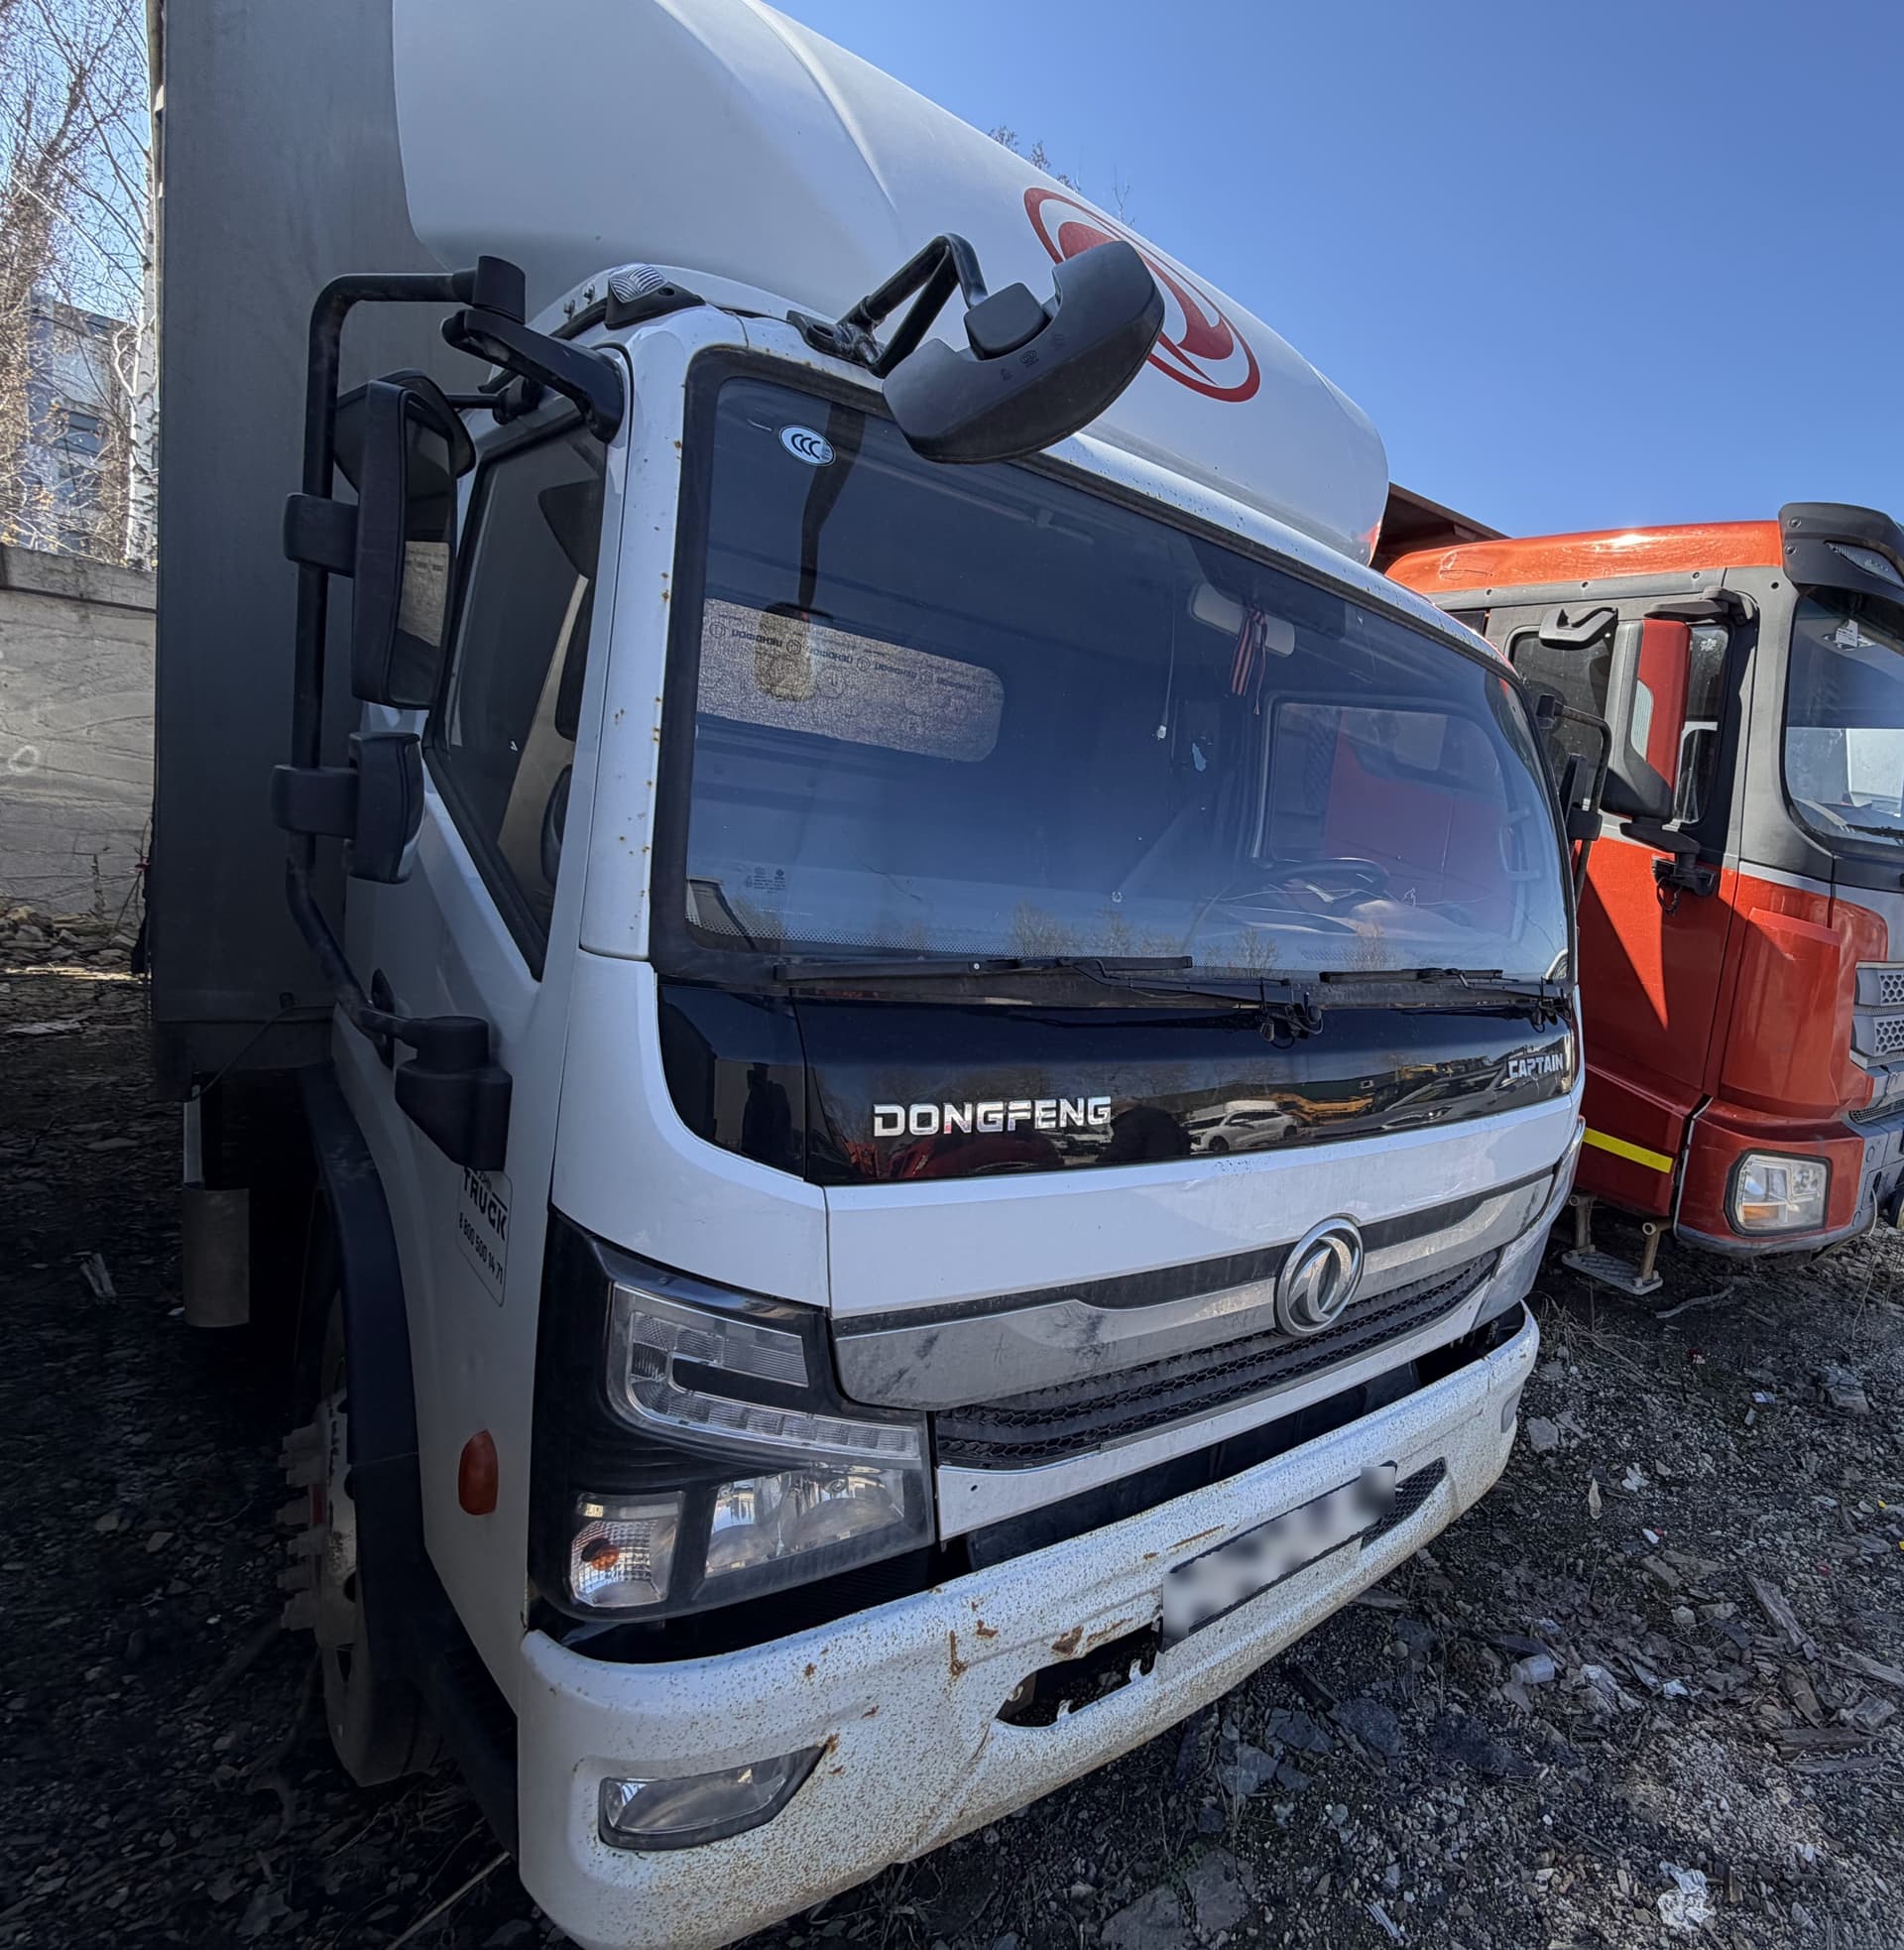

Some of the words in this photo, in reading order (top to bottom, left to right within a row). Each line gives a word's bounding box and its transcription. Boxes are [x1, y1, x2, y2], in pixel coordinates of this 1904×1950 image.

[1507, 1053, 1564, 1079] CAPTAIN
[873, 1095, 1112, 1138] DONGFENG
[463, 1166, 507, 1242] TRUCK
